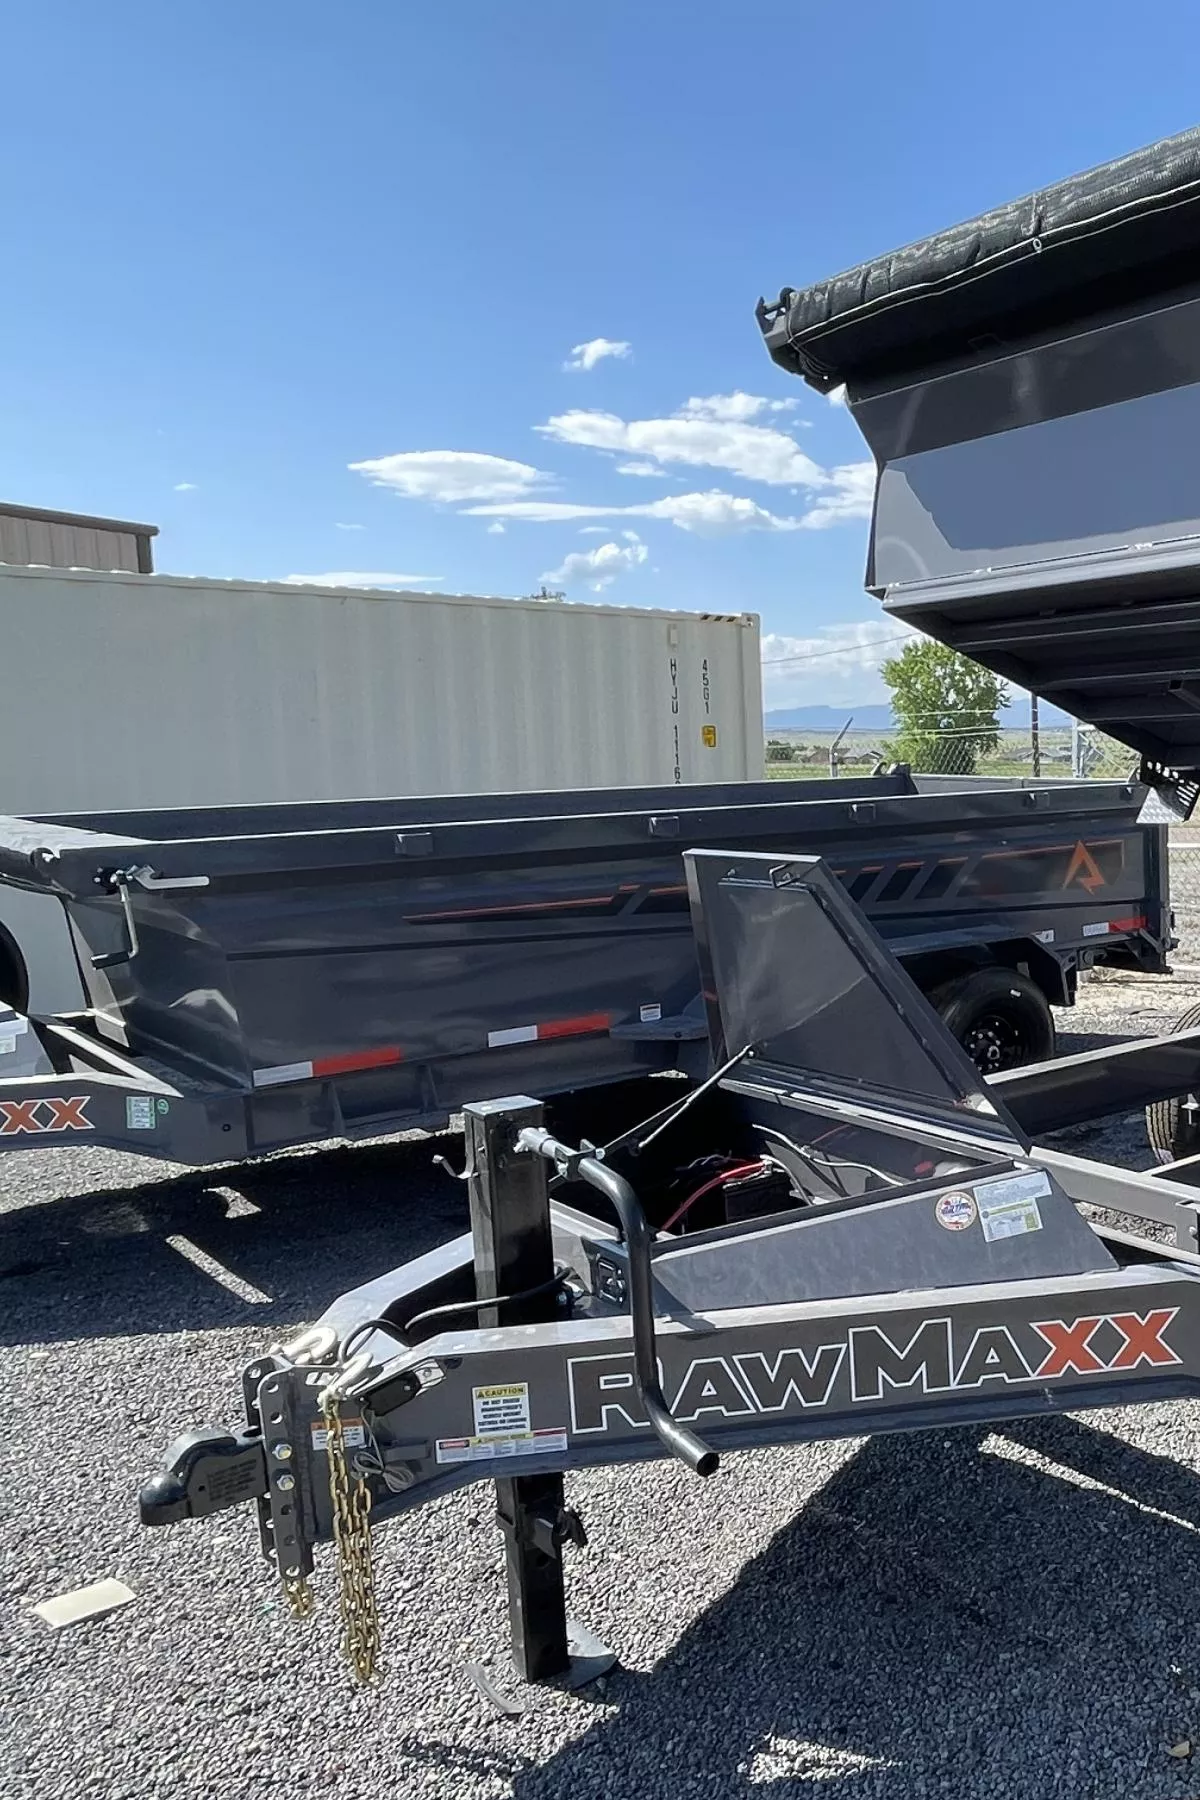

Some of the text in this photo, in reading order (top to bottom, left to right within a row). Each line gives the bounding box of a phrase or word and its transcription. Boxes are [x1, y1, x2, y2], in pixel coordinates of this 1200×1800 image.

[670, 658, 679, 714] HYJU
[485, 1387, 524, 1397] CAUTION
[567, 1306, 1184, 1435] RAWMAXX
